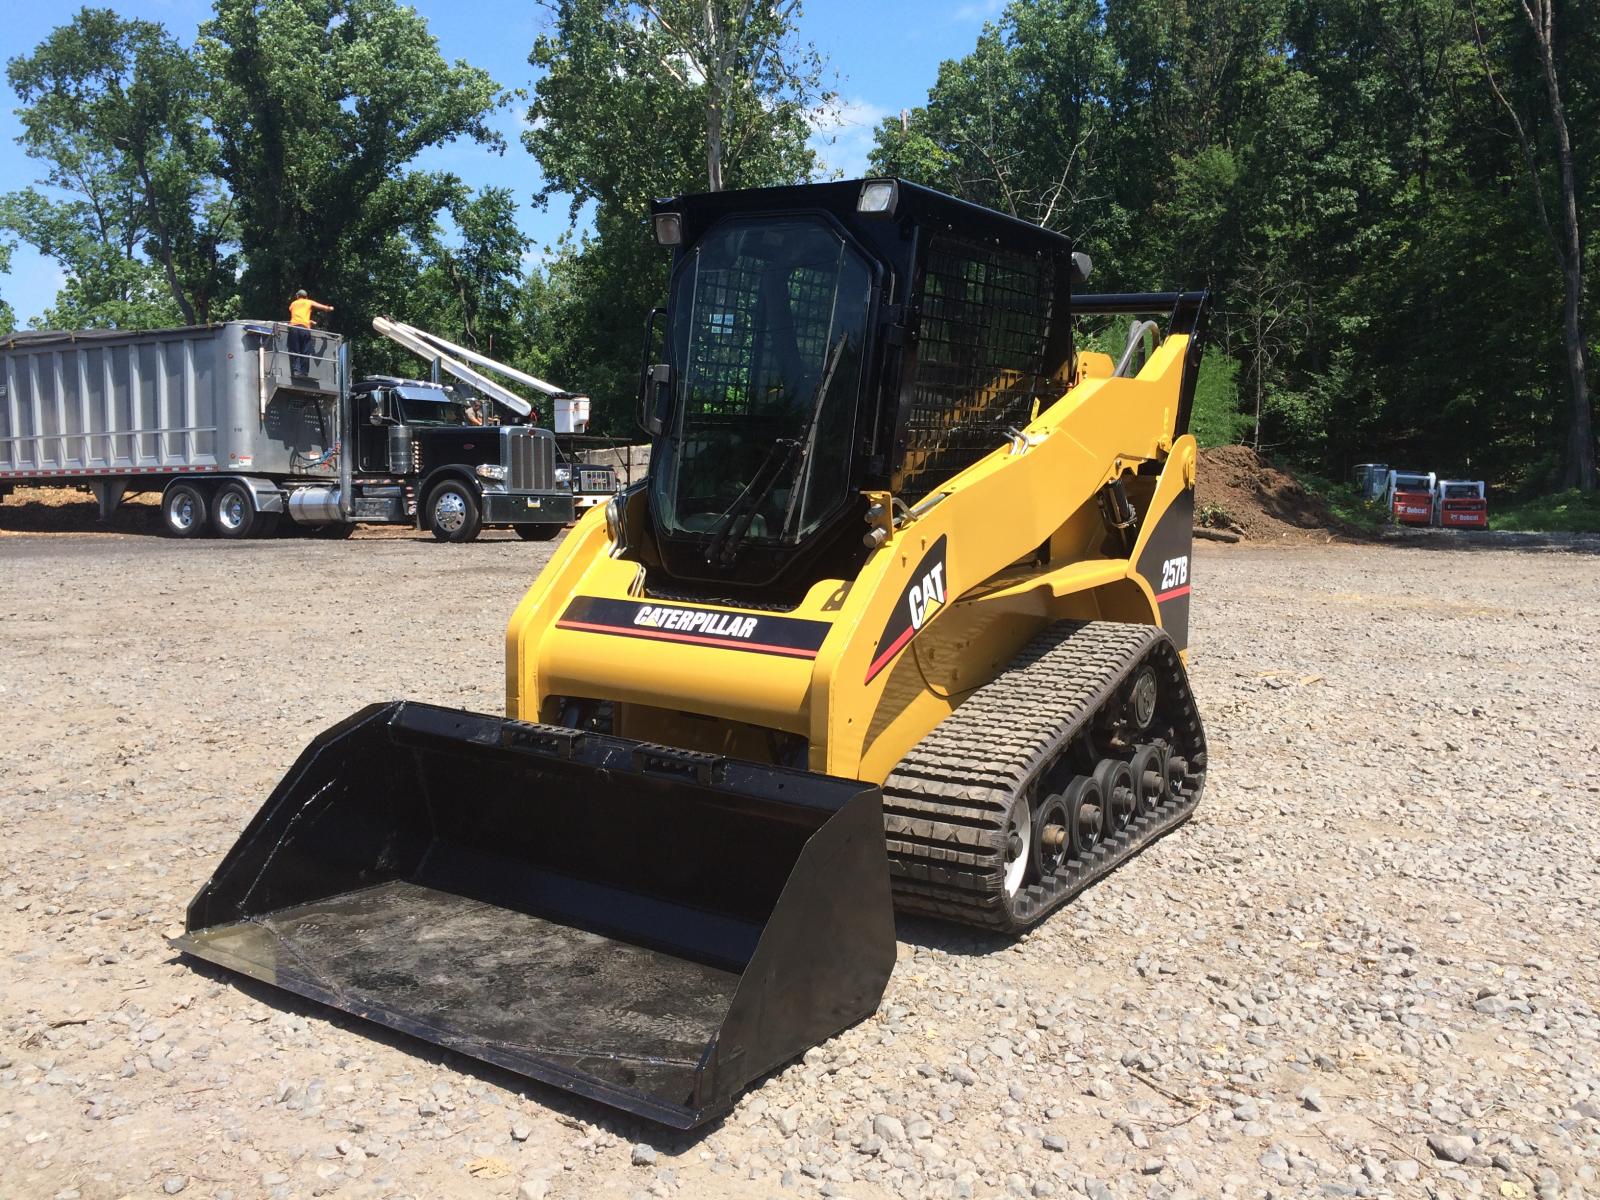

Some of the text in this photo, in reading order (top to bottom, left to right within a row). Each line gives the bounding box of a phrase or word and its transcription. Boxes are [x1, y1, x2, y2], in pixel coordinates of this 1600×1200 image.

[1161, 556, 1187, 590] 257B
[908, 561, 944, 629] CAT
[634, 606, 757, 638] CATERPILLAR
